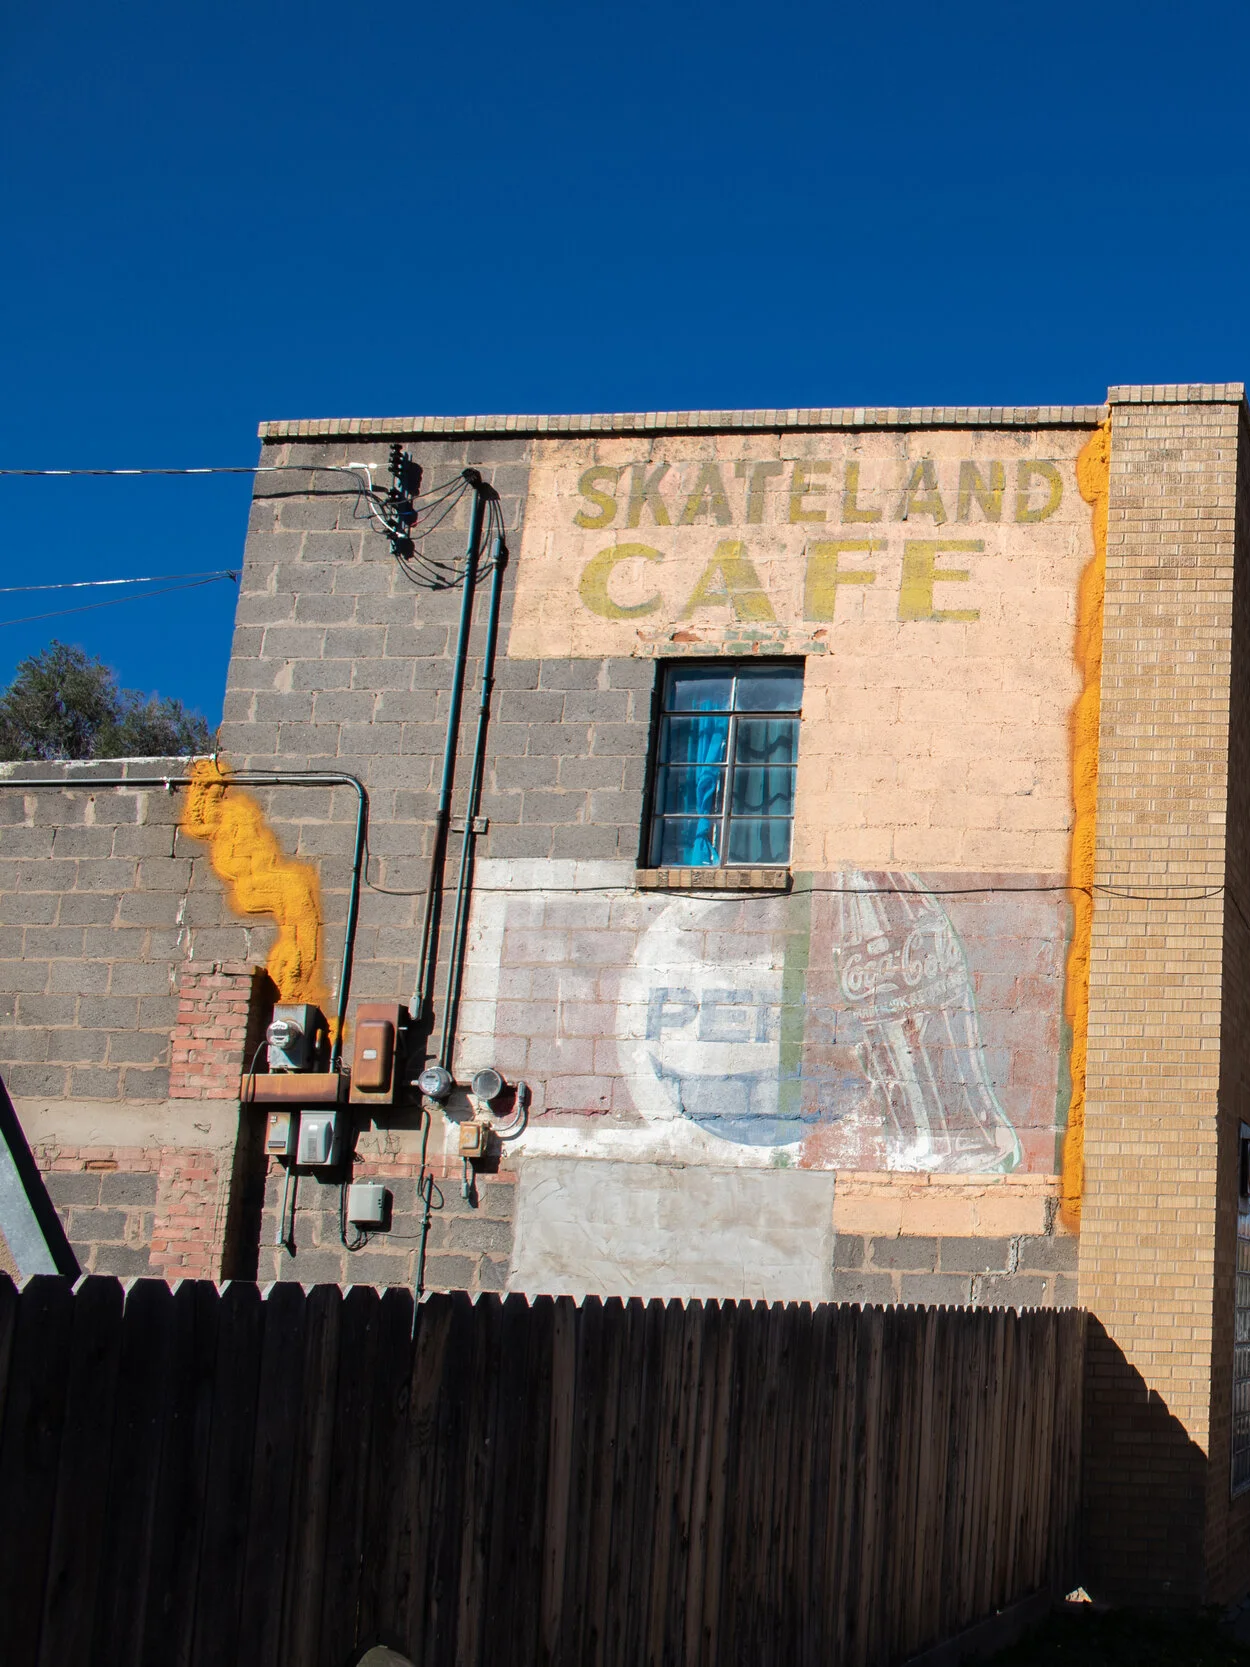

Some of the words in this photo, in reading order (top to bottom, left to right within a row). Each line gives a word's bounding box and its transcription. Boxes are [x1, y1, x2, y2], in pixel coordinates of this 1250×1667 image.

[573, 460, 1064, 529] SKATELAND
[578, 539, 985, 622] CAFE
[841, 922, 963, 1000] Coca-Cola
